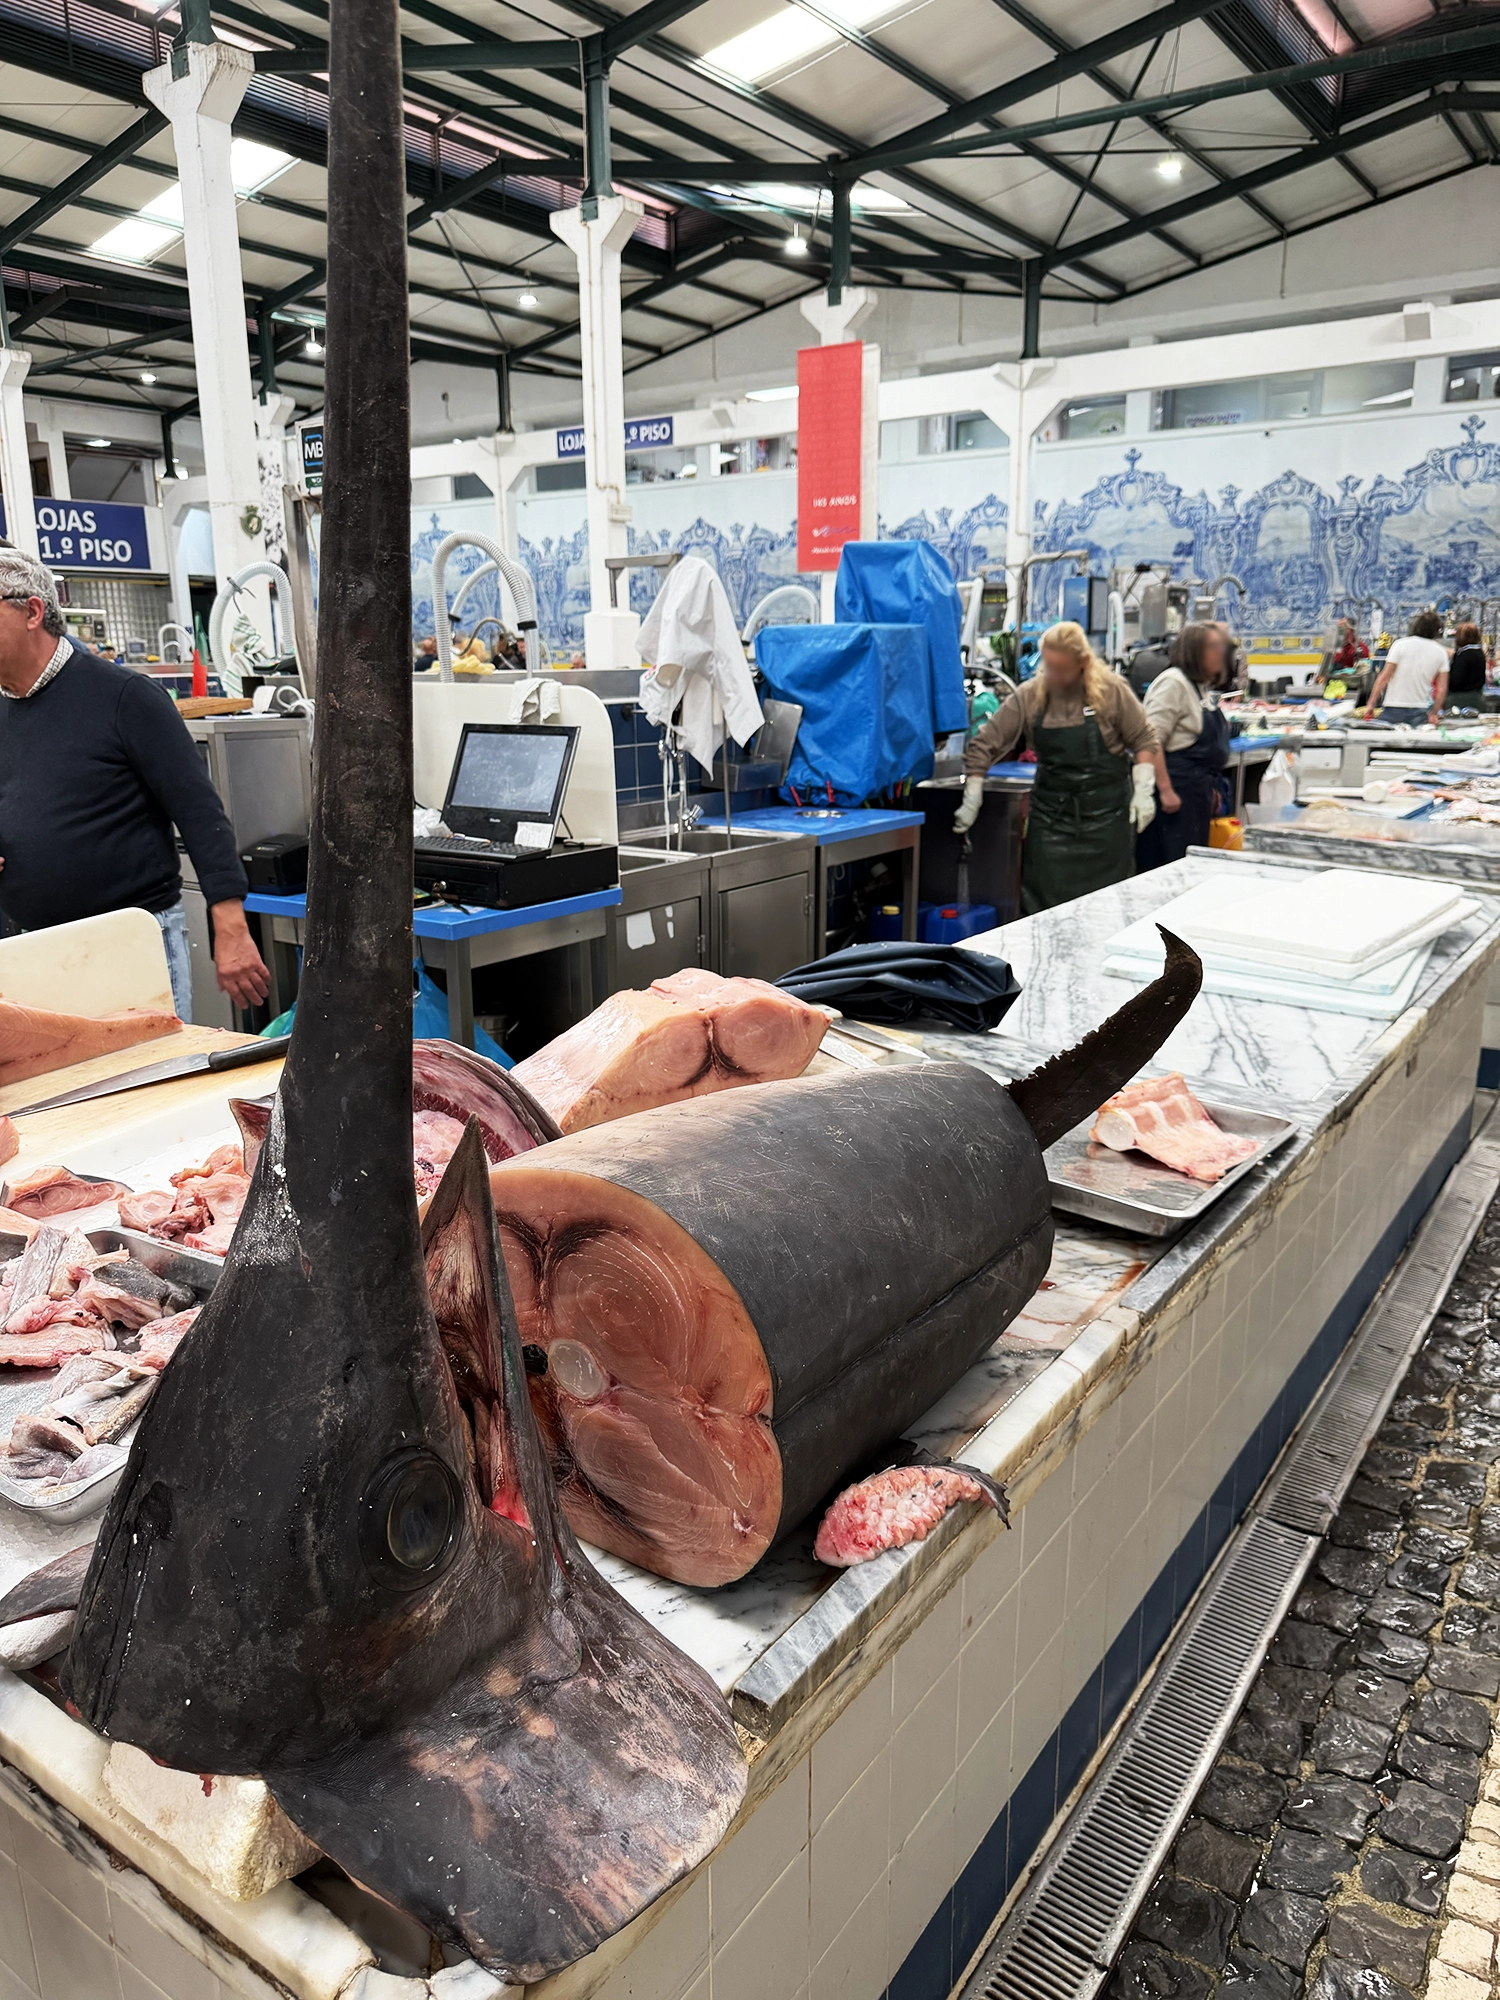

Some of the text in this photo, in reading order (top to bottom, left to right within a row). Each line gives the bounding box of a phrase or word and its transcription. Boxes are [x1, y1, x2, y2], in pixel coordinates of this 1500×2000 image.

[640, 423, 670, 442] PISO
[305, 441, 323, 460] MB
[40, 535, 132, 562] 1.º PISO
